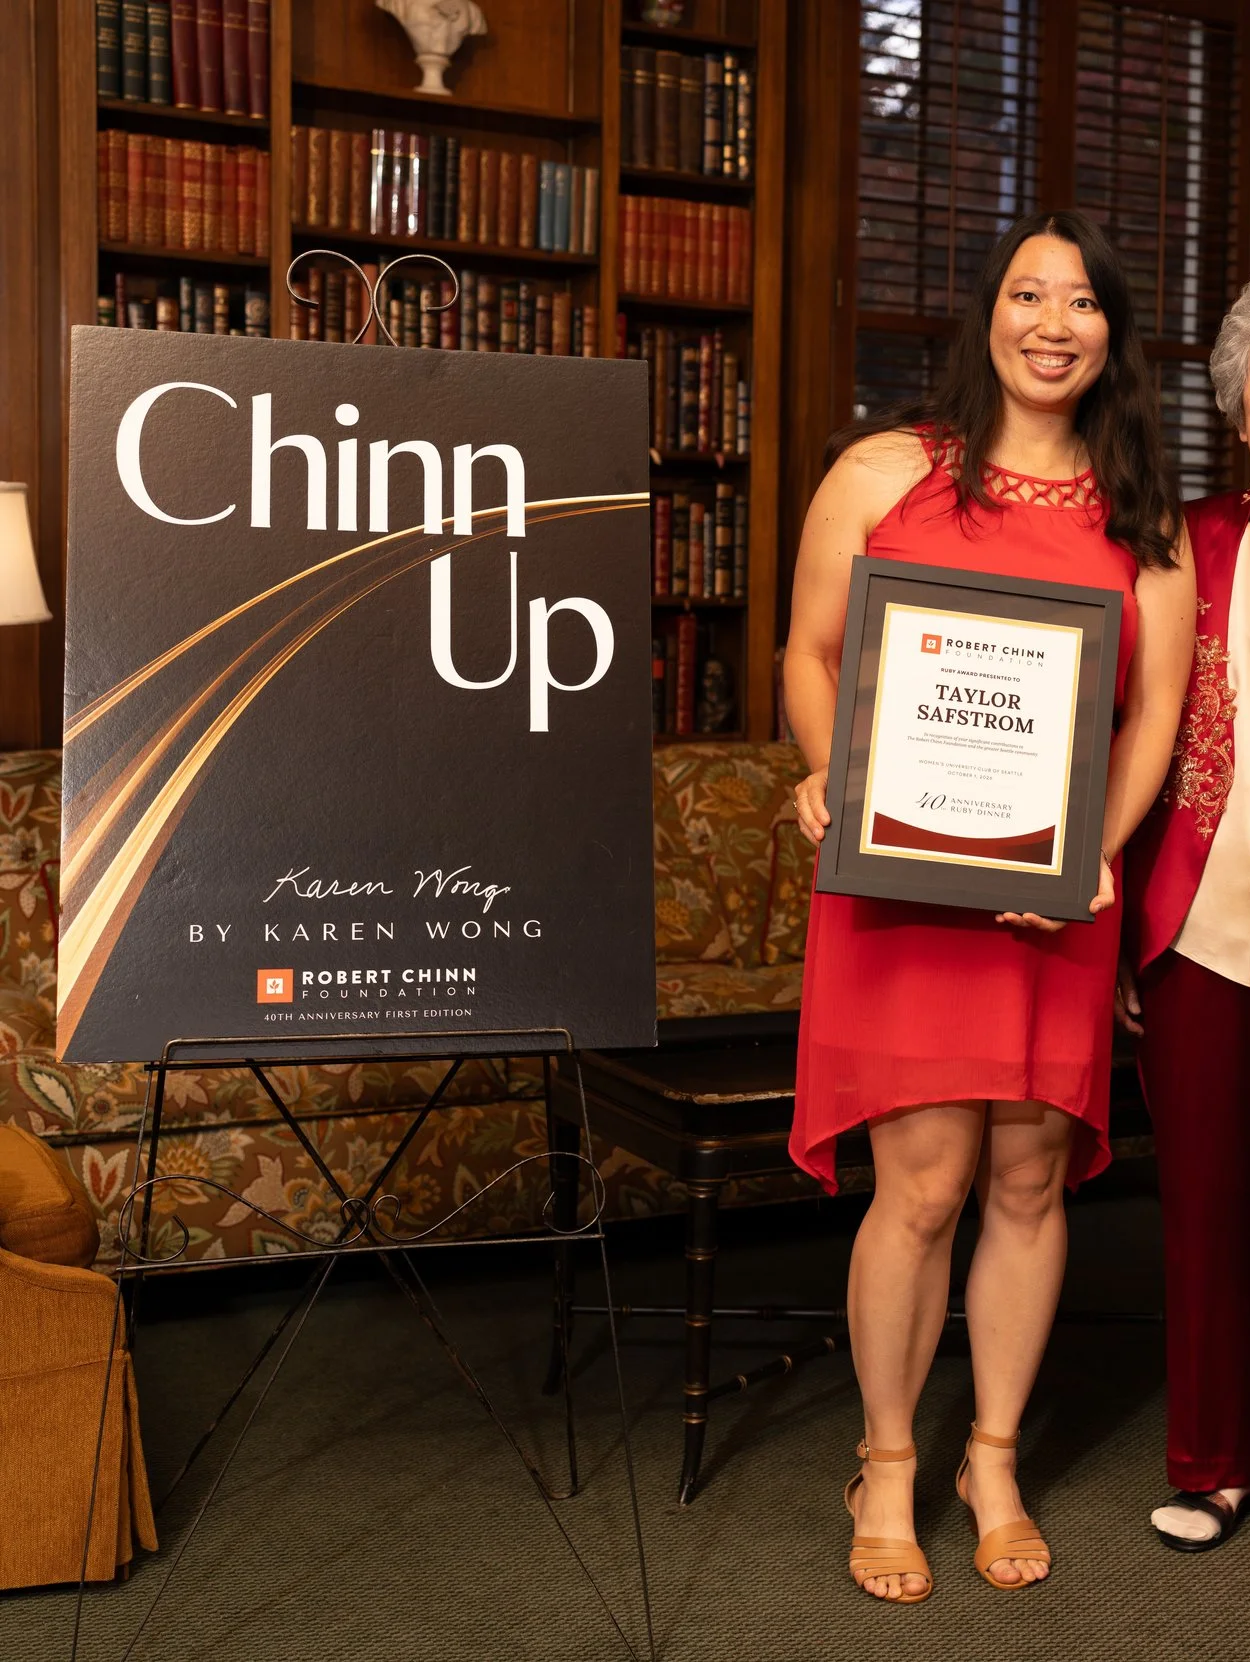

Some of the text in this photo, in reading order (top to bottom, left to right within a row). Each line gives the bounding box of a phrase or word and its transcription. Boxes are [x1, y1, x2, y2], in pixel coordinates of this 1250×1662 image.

[115, 381, 527, 537] Chinn
[430, 551, 615, 732] Up
[946, 638, 1045, 660] ROBERT CHINN
[945, 649, 1044, 668] FOUNDATION
[957, 669, 978, 677] AWARD
[979, 673, 1012, 682] PRESENTED
[935, 684, 1021, 710] TAYLOR
[917, 704, 1035, 734] SAFSTROM
[945, 762, 976, 771] UNIVERSITY
[1001, 769, 1023, 777] SEATTLE
[947, 770, 973, 778] OCTOBER
[950, 798, 1013, 811] ANNIVERSARY
[950, 806, 1012, 819] RUBY DINNER
[262, 865, 511, 914] Karen Wong
[189, 919, 543, 943] BY KAREN WONG
[302, 967, 477, 985] ROBERT CHINN
[302, 986, 476, 1000] FOUNDATION
[264, 1008, 473, 1022] 40TH ANNIVERSARY FIRST EDITION
